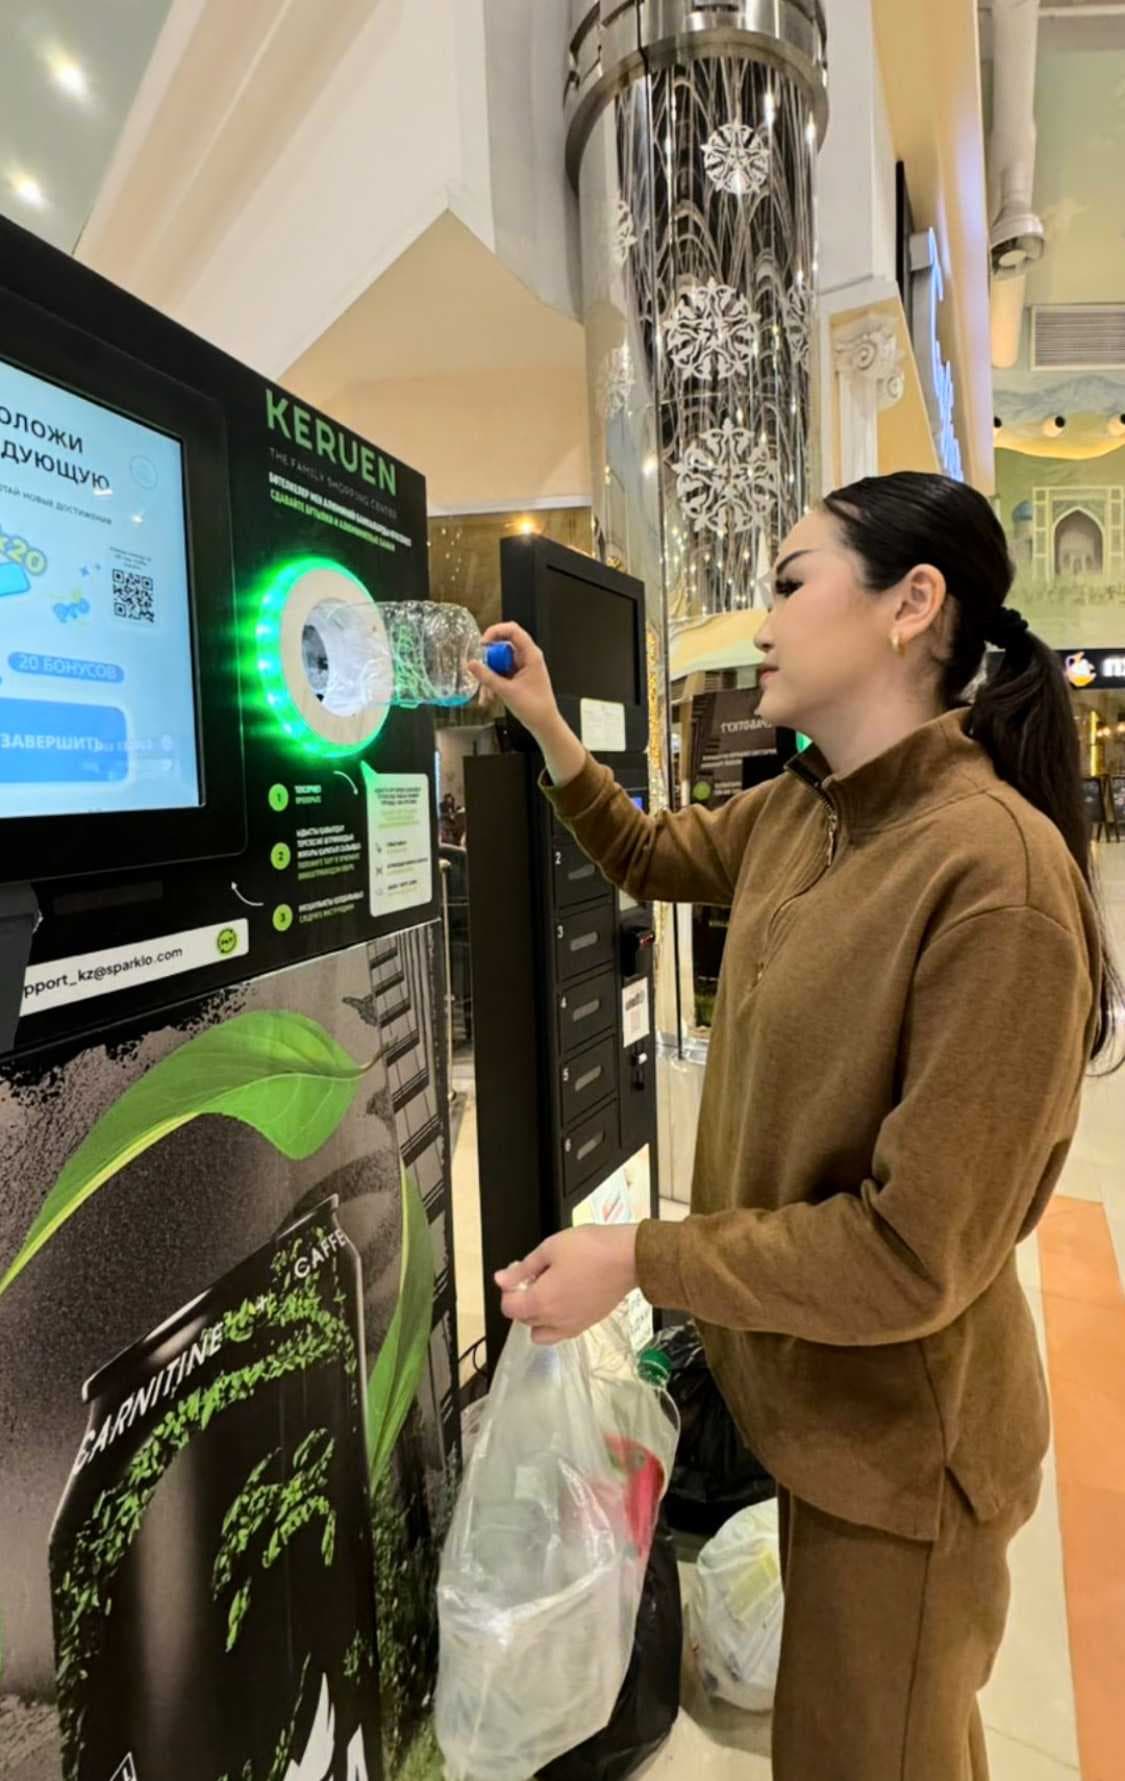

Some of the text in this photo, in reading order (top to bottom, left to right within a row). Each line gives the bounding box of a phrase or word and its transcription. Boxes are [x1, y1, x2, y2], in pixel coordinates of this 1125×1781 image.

[265, 388, 397, 497] KERUEN
[1, 440, 110, 491] ДУЮЩУЮ
[19, 655, 118, 681] 20 БОНУСОВ
[1, 733, 104, 752] ЗАВЕРШИТЬ
[555, 851, 562, 865] 2
[556, 925, 564, 939] 3
[72, 1321, 224, 1475] CARNITINE
